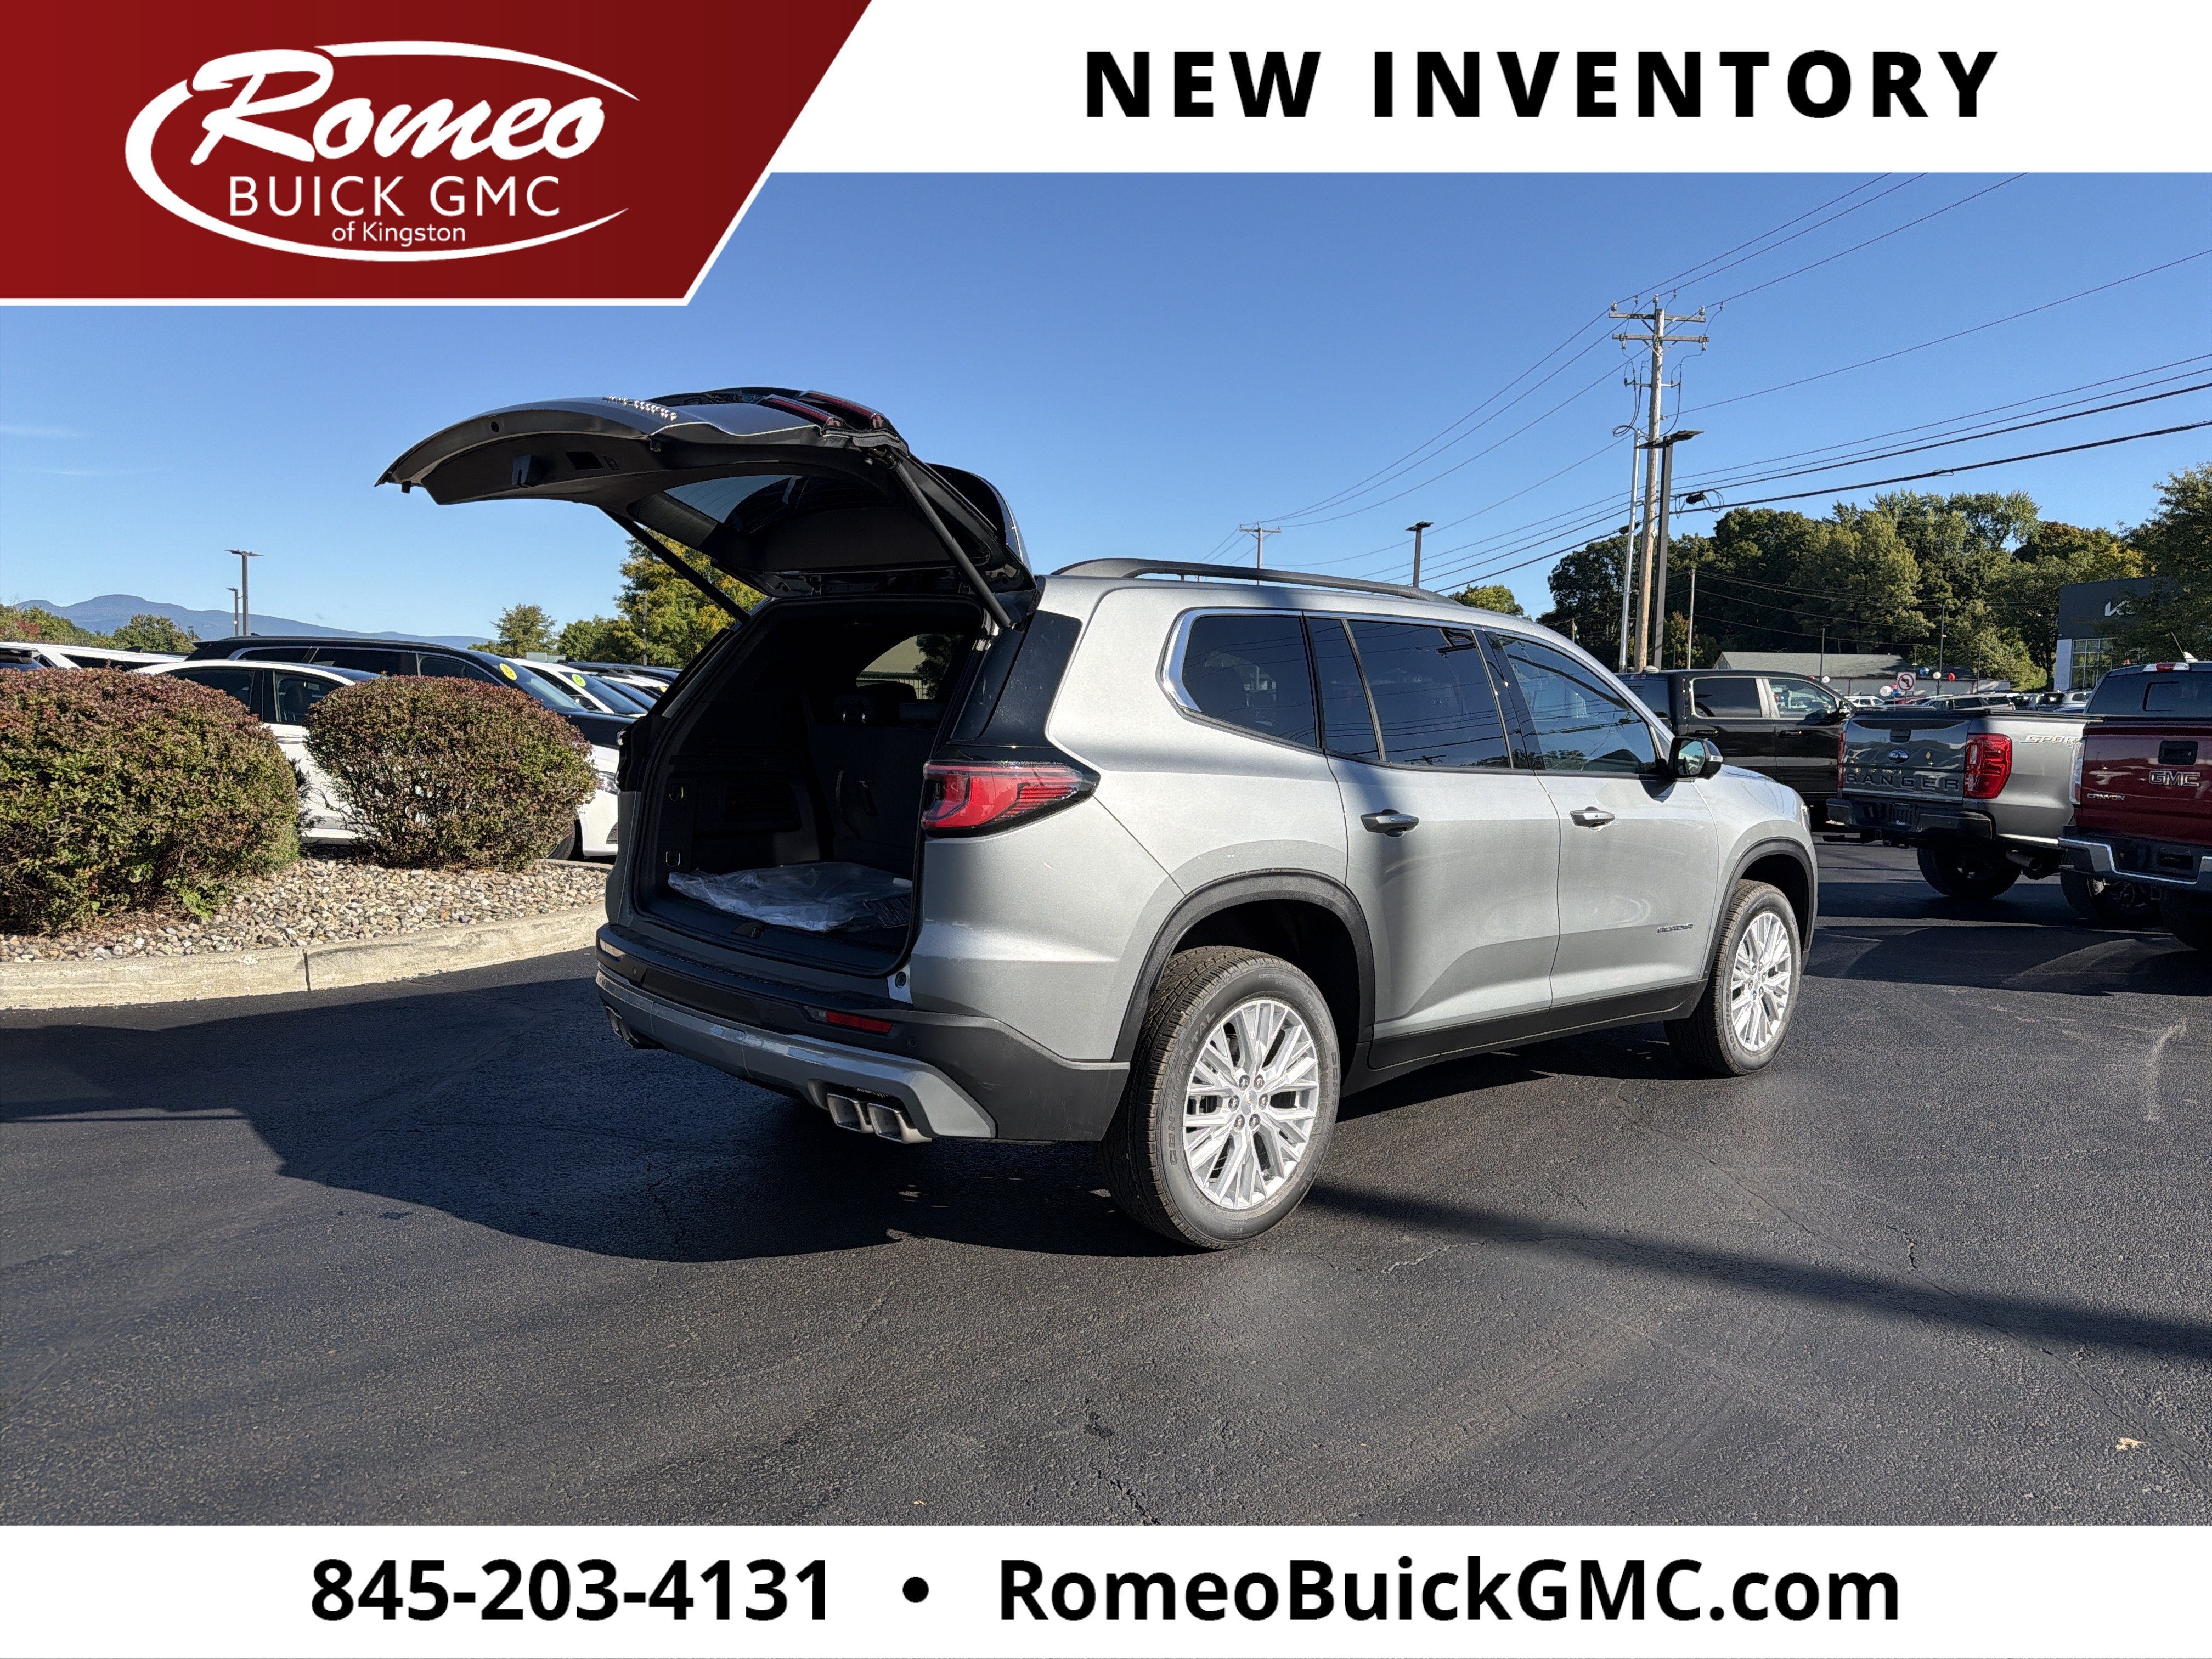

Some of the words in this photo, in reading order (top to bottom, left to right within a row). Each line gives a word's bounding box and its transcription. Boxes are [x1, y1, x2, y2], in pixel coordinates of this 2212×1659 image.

[1846, 772, 1959, 792] RANGER
[2149, 770, 2200, 787] GMC
[2087, 793, 2125, 801] CANYON
